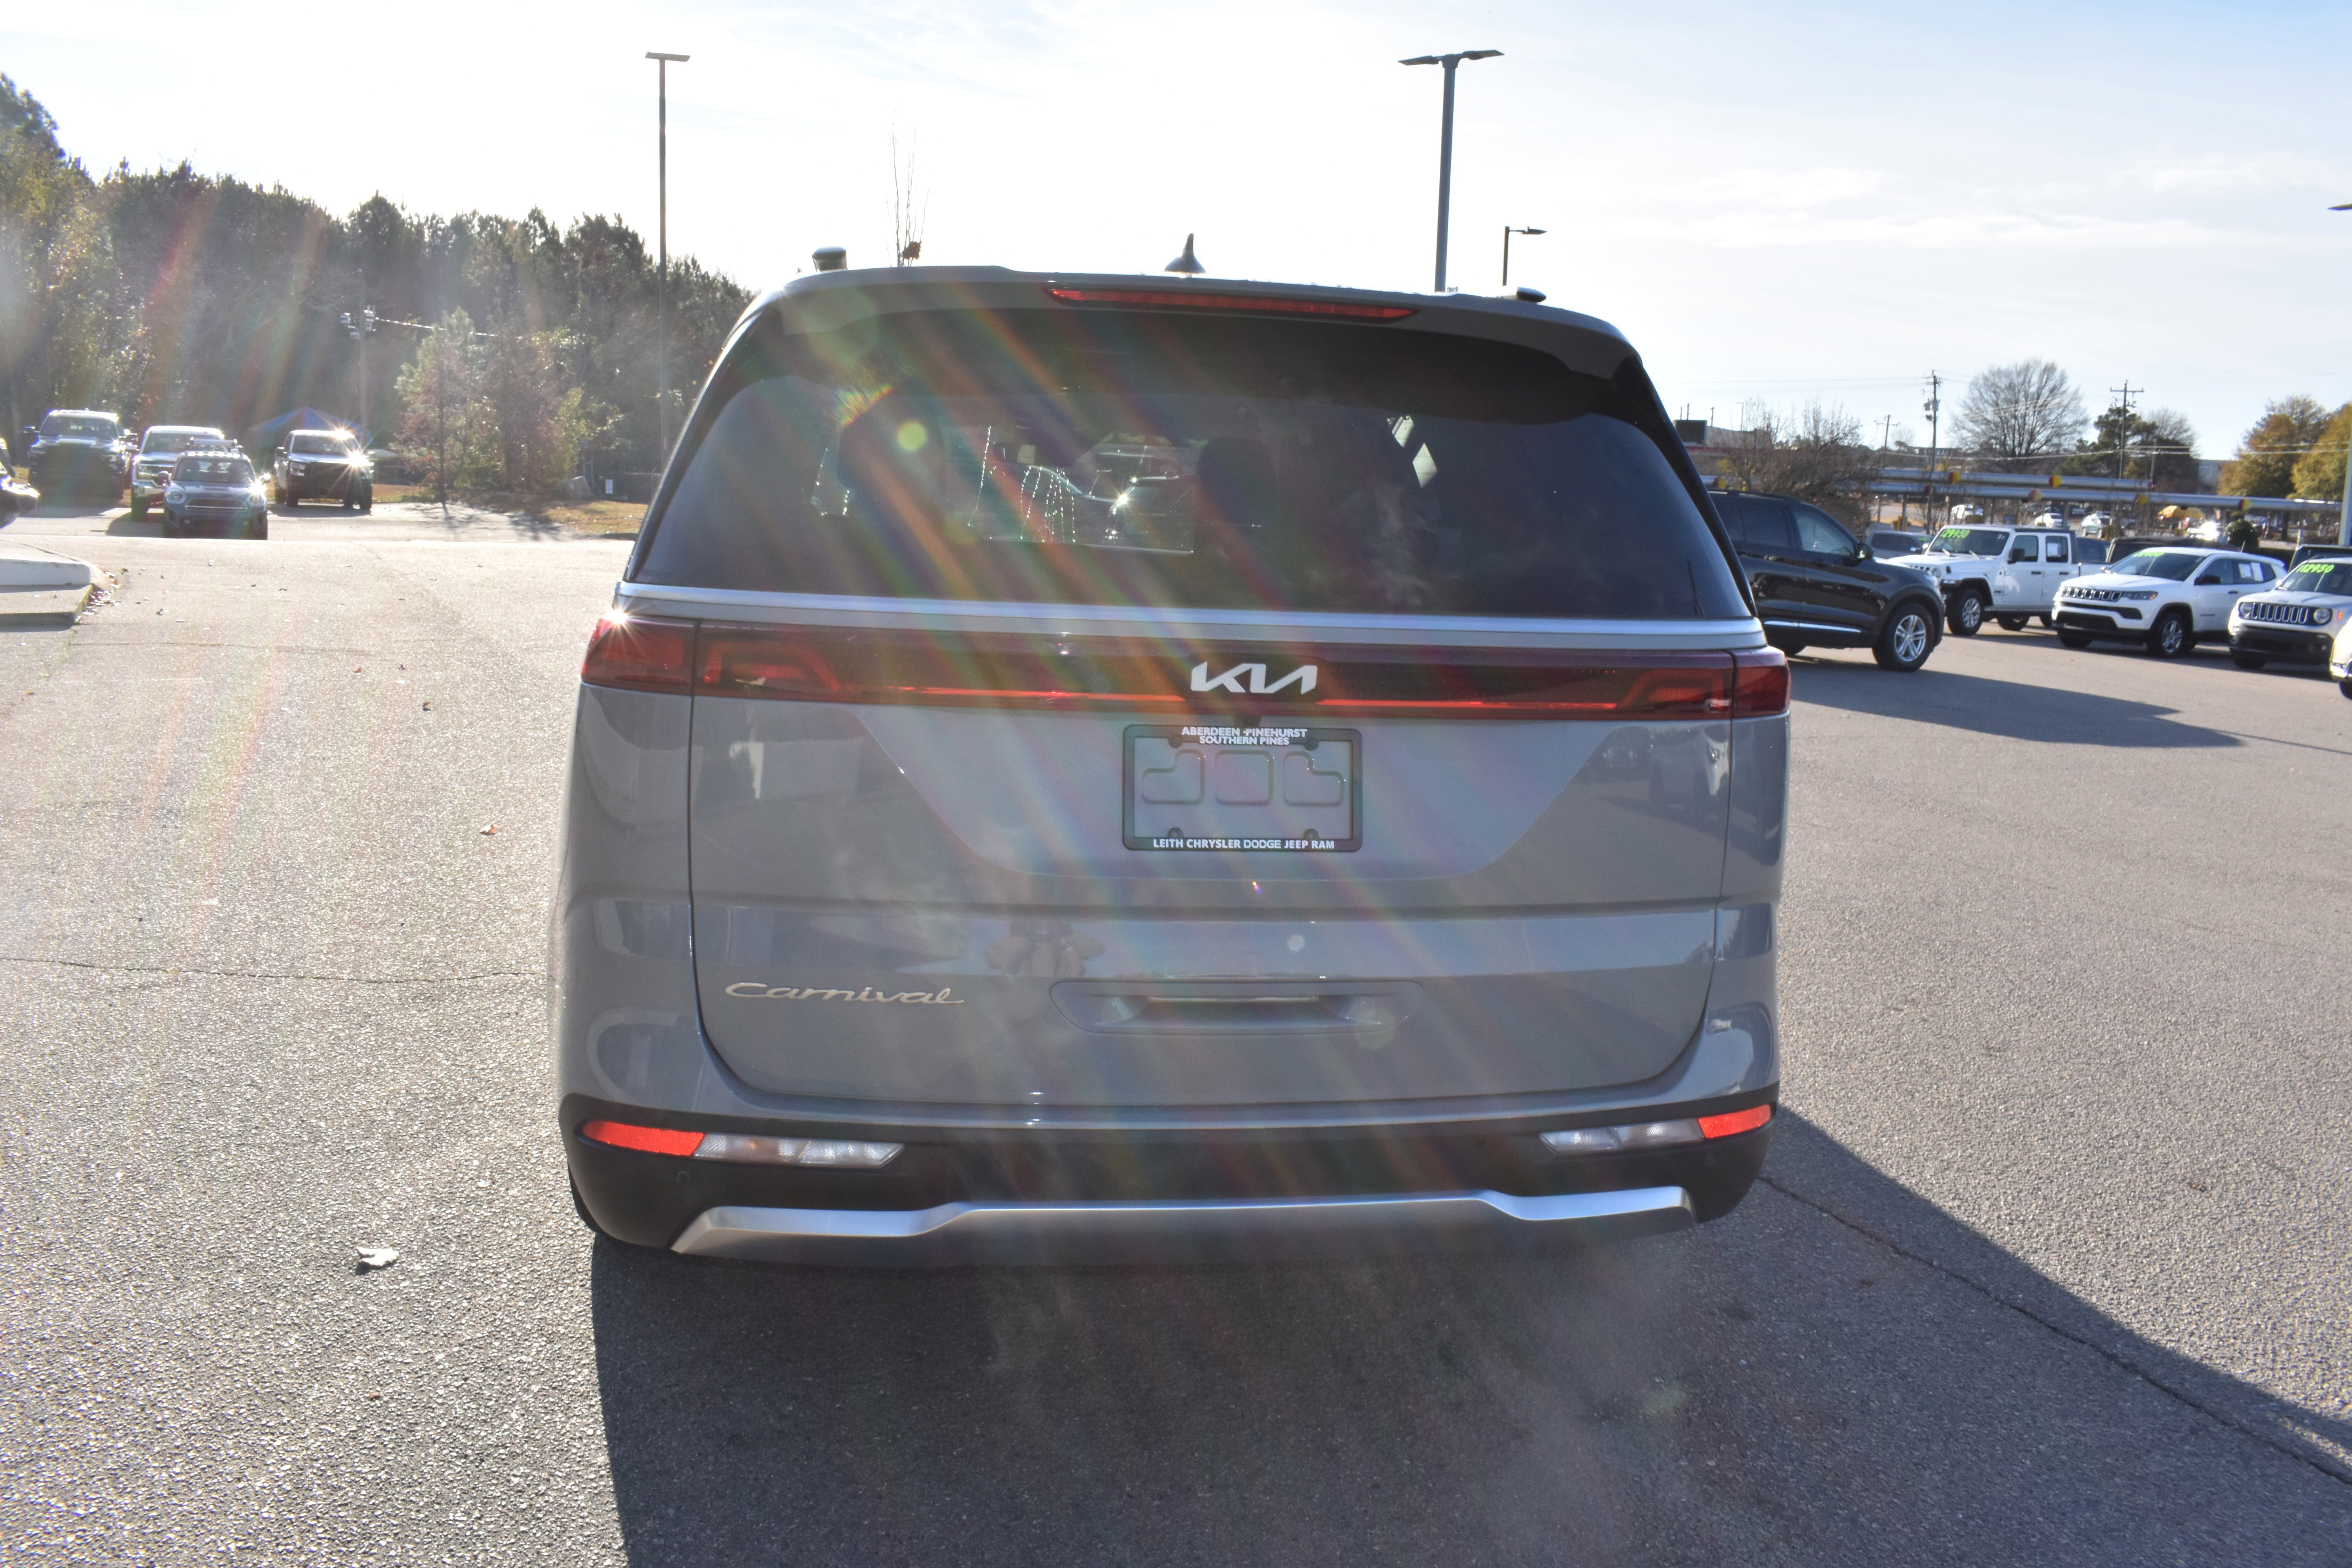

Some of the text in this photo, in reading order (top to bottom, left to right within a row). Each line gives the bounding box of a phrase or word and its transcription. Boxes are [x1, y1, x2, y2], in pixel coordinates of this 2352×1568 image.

[1190, 662, 1318, 694] KIA
[1182, 726, 1308, 737] ABERDEEN PINEHURST
[1199, 735, 1290, 745] SOUTHERN PINES
[1153, 839, 1334, 849] LEITH CHRYSLER DODGE JEEP RAM
[725, 982, 964, 1004] Carnival
